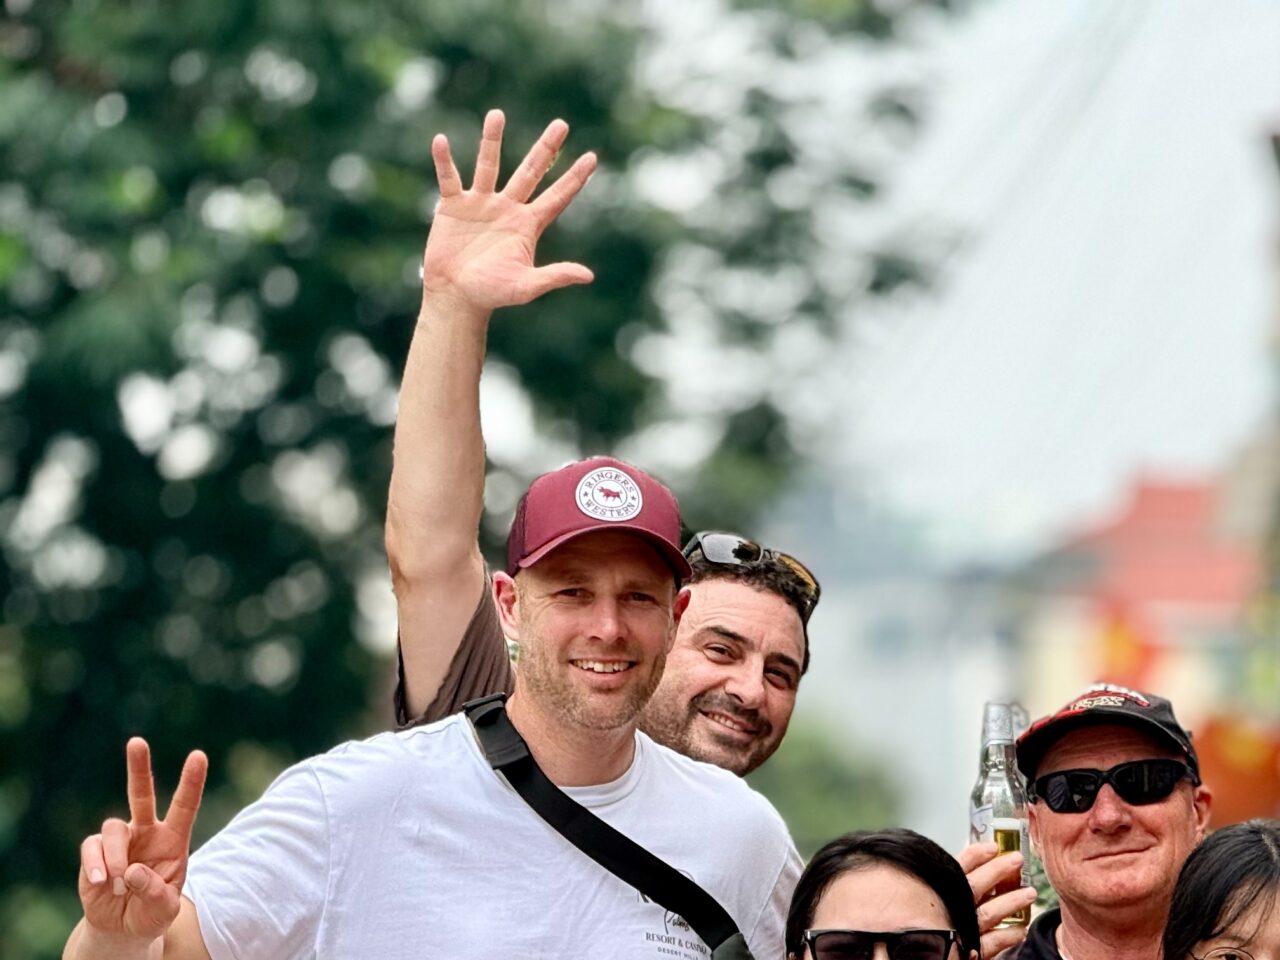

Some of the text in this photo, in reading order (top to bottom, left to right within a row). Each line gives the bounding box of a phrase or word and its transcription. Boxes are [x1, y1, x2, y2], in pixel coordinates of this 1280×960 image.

[585, 471, 634, 492] RINGERS
[585, 499, 635, 517] WESTERN
[646, 932, 707, 955] RESORT & CASINO
